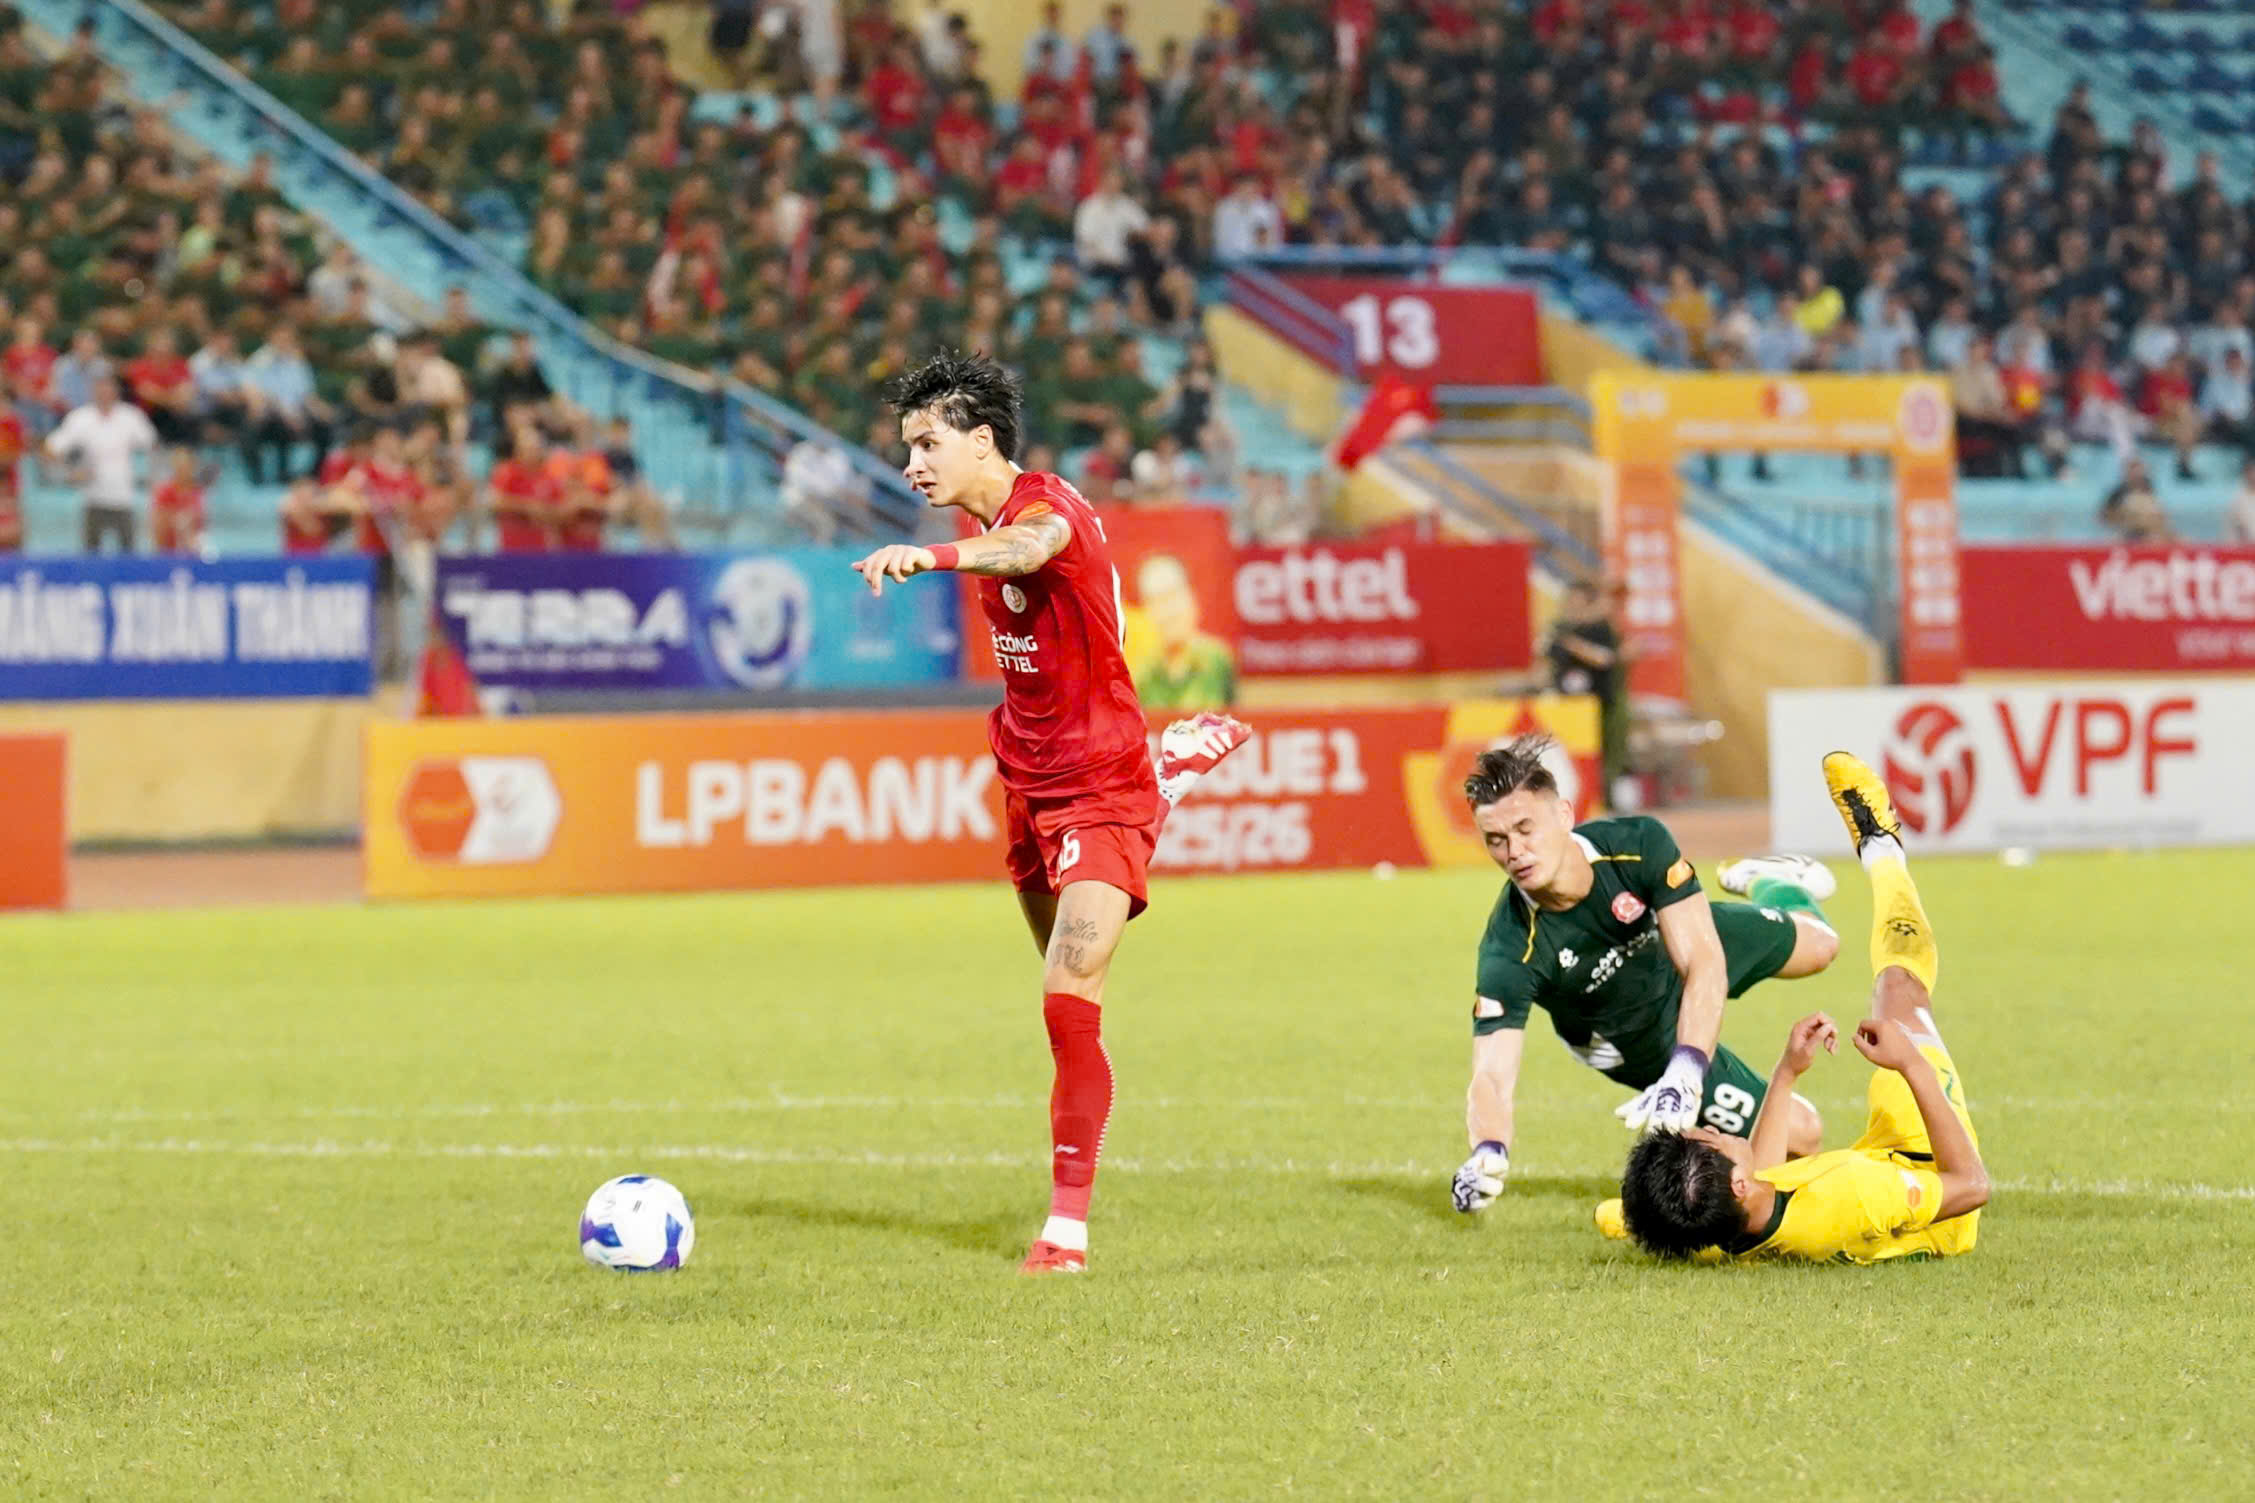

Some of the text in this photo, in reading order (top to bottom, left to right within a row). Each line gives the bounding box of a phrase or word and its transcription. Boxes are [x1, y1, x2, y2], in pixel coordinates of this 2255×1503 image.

[1341, 293, 1439, 368] 13
[1233, 548, 1420, 623] ettel
[2068, 549, 2255, 621] viette
[995, 652, 1039, 673] ETTEL
[1328, 730, 1368, 794] 1
[1995, 697, 2196, 797] VPF
[636, 756, 997, 847] LPBANK
[1704, 1083, 1756, 1133] 89
